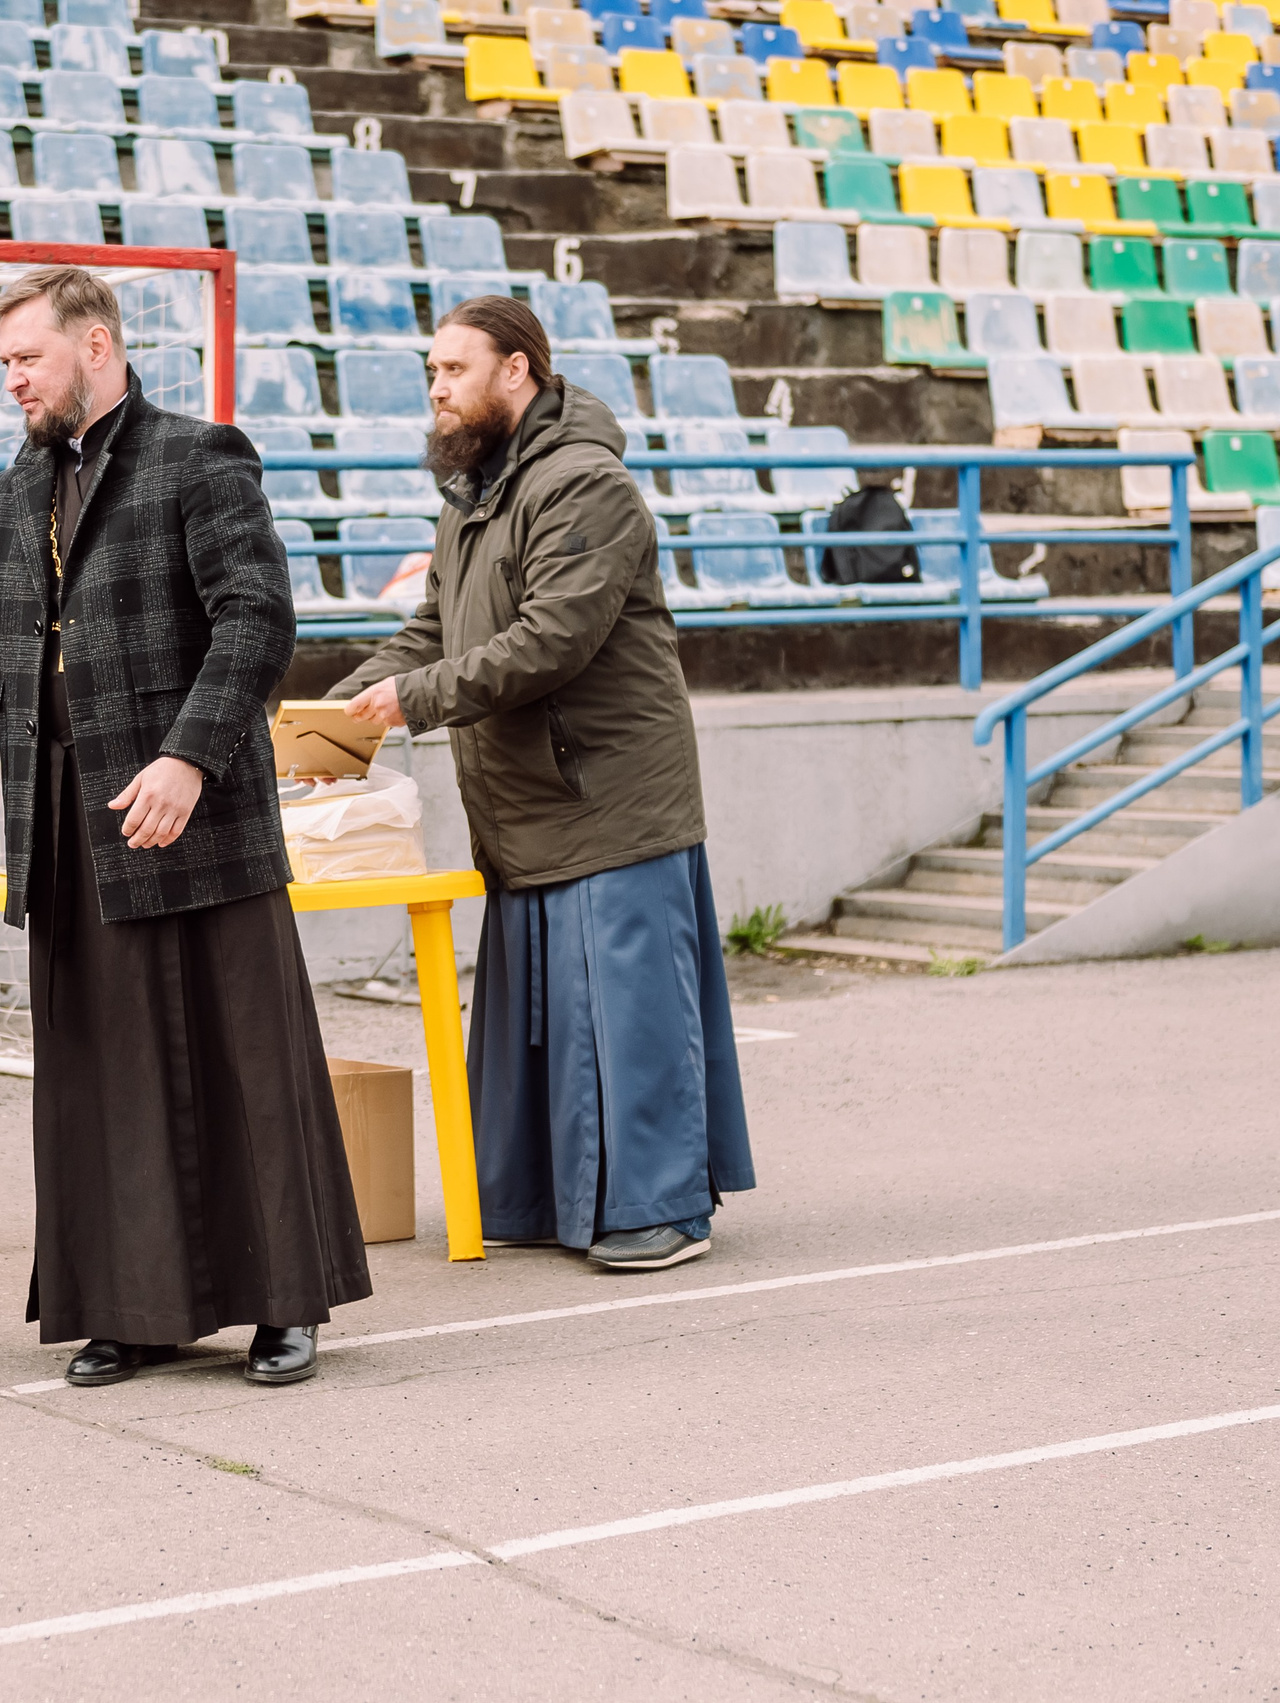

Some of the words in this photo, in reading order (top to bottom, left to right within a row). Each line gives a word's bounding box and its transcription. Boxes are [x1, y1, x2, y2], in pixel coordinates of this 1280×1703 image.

[449, 170, 478, 208] 7
[553, 237, 584, 285] 6
[650, 317, 680, 356] 5
